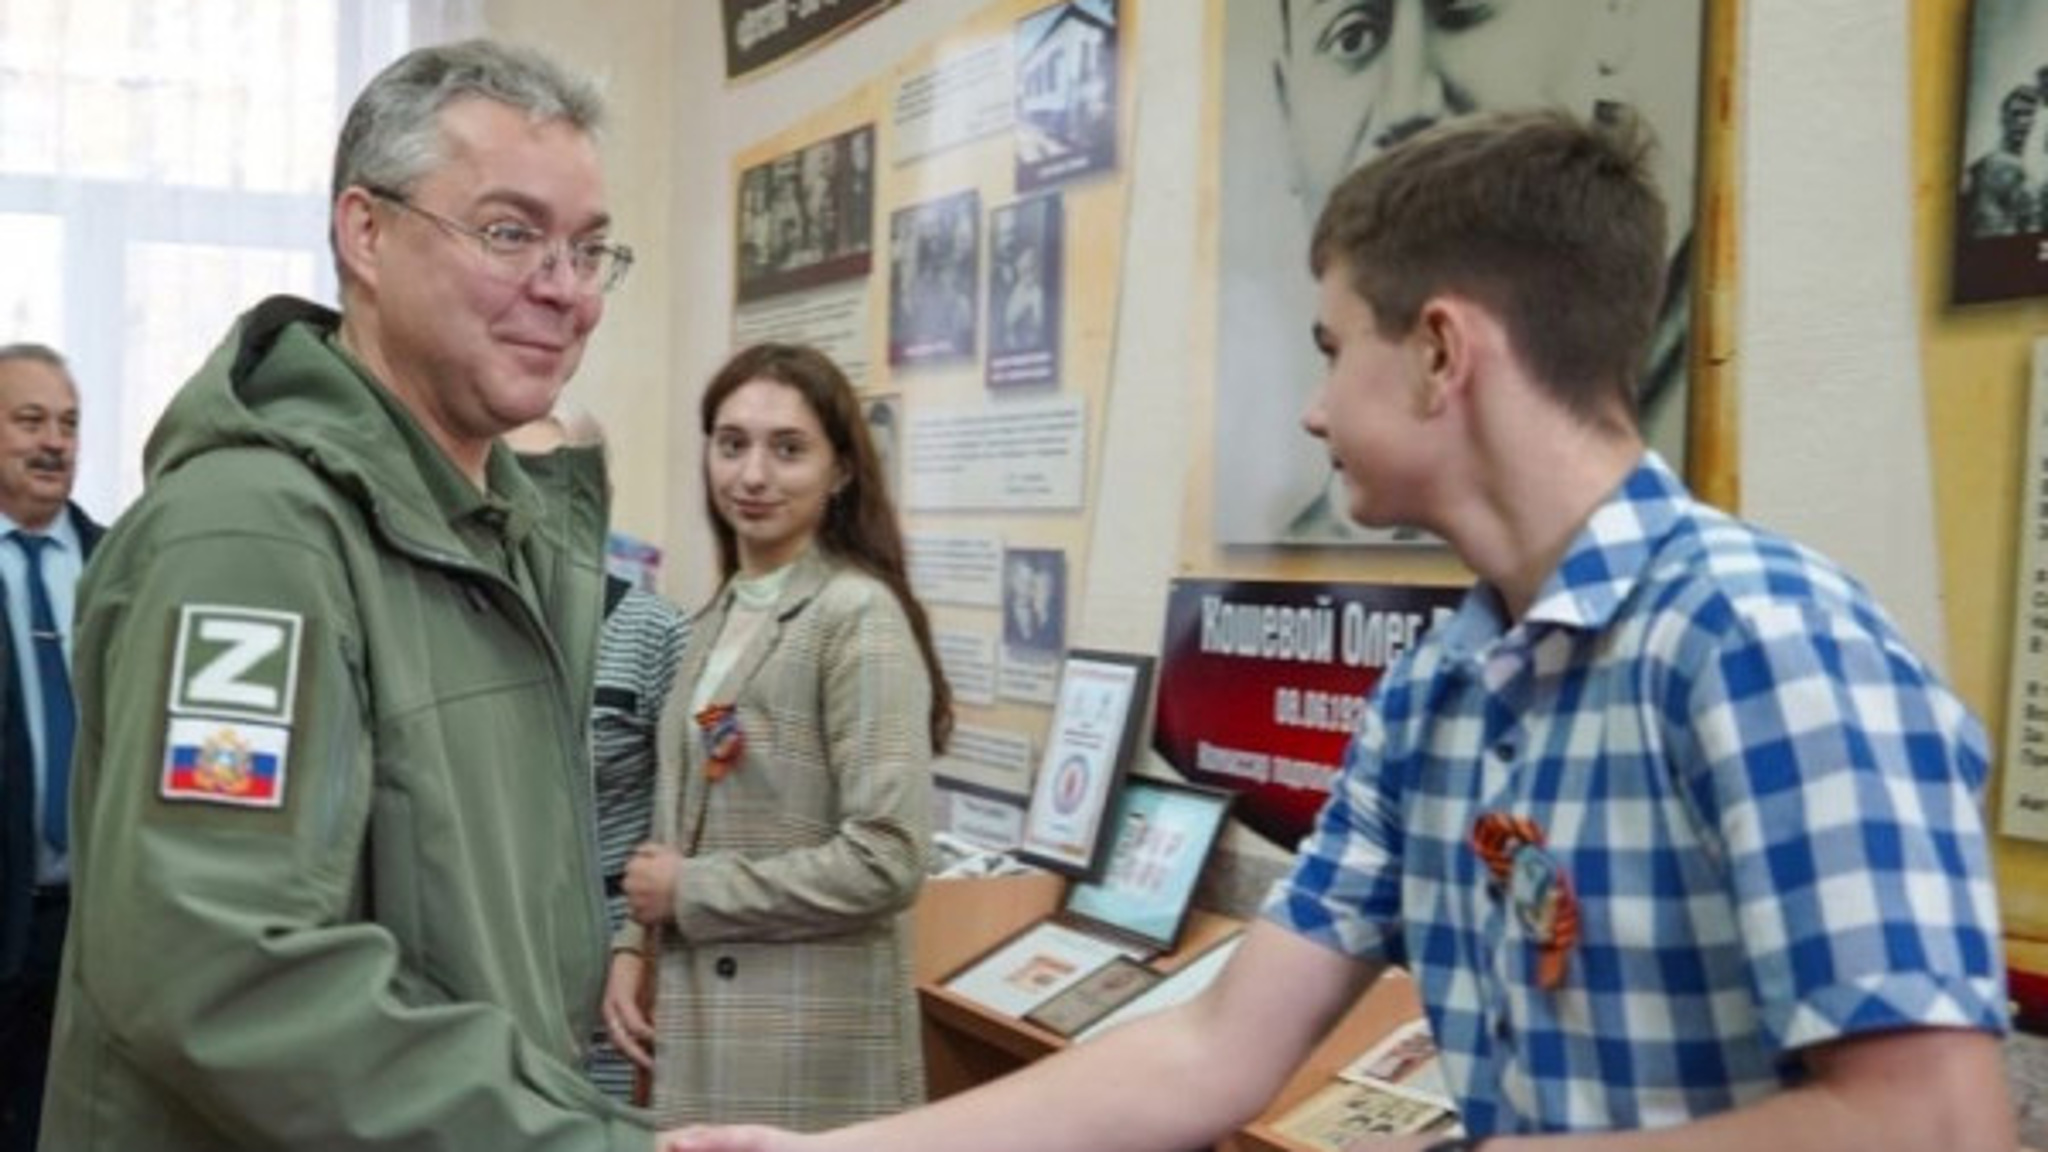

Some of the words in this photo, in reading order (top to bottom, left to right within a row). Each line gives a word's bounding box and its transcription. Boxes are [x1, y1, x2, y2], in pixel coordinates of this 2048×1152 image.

[186, 617, 285, 709] Z
[1201, 595, 1334, 663] Кошевой
[1341, 601, 1423, 668] Олег
